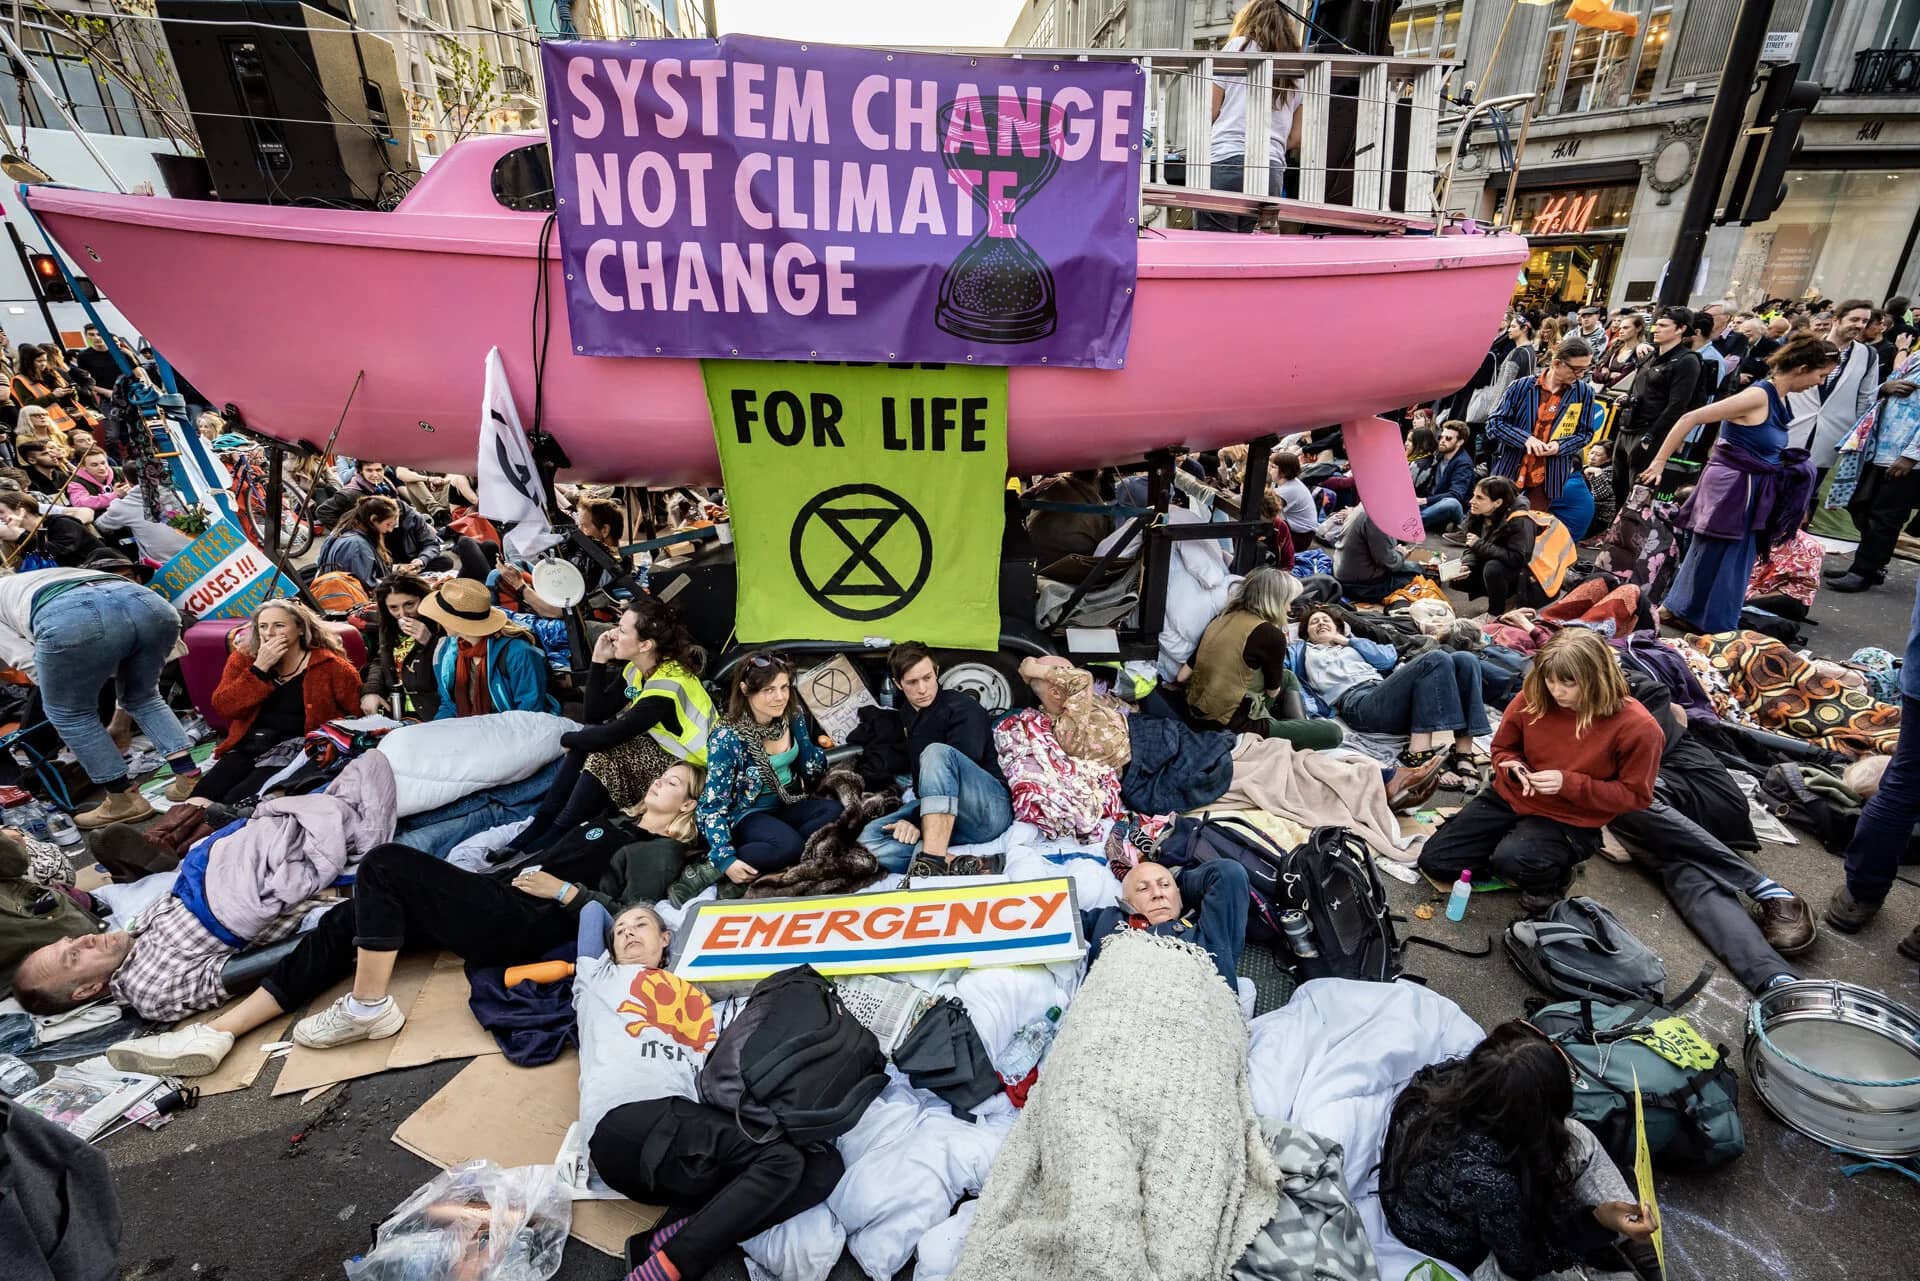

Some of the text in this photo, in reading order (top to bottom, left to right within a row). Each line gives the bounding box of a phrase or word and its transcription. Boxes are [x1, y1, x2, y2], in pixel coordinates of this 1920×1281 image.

[567, 56, 1132, 162] SYSTEM CHANGE
[1855, 120, 1885, 141] H&M
[1551, 139, 1582, 159] H&M
[575, 151, 1018, 239] NOT CLIMATE
[1531, 194, 1598, 235] H&M
[585, 238, 857, 316] CHANGE
[731, 389, 988, 452] FOR LIFE
[165, 555, 205, 591] OUR
[191, 525, 244, 569] PEER
[702, 892, 1068, 950] EMERGENCY
[641, 1040, 674, 1060] IT'S
